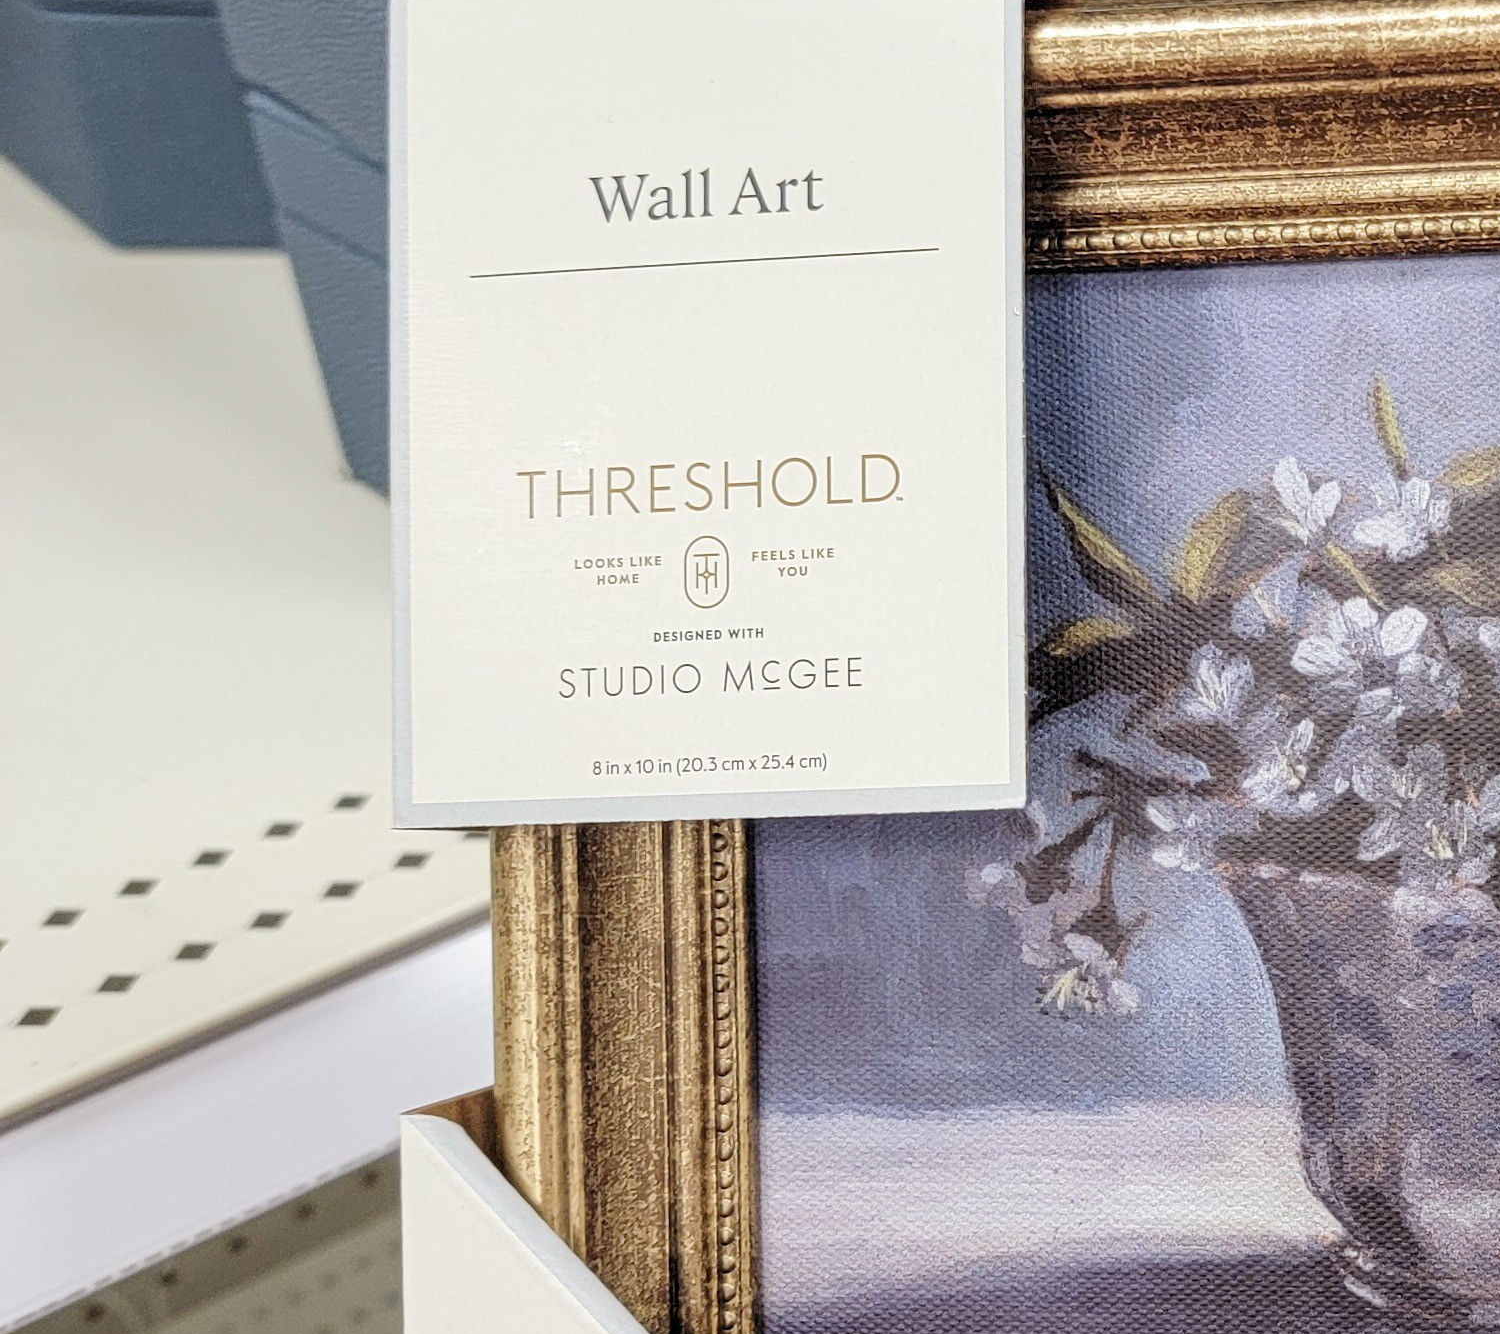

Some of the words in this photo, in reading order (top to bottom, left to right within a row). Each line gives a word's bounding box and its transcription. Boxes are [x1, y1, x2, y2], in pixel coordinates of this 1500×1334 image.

[588, 166, 714, 224] Wall
[727, 166, 825, 216] Art
[751, 549, 797, 562] FEELS
[801, 547, 835, 560] LIKE
[574, 557, 625, 570] LOOKS
[629, 555, 663, 568] LIKE
[777, 565, 808, 578] YOU
[596, 573, 640, 586] HOME
[653, 629, 723, 643] DESIGNED
[727, 627, 764, 640] WITH
[558, 663, 702, 699] STUDIO
[592, 760, 603, 776] 8
[605, 759, 620, 776] in
[623, 763, 632, 775] x
[635, 758, 655, 774] 10
[658, 757, 673, 774] in
[676, 757, 718, 777] (20.3
[721, 759, 745, 772] cm
[748, 759, 758, 771] x
[760, 754, 795, 770] 25.4
[799, 752, 828, 772] cm)
